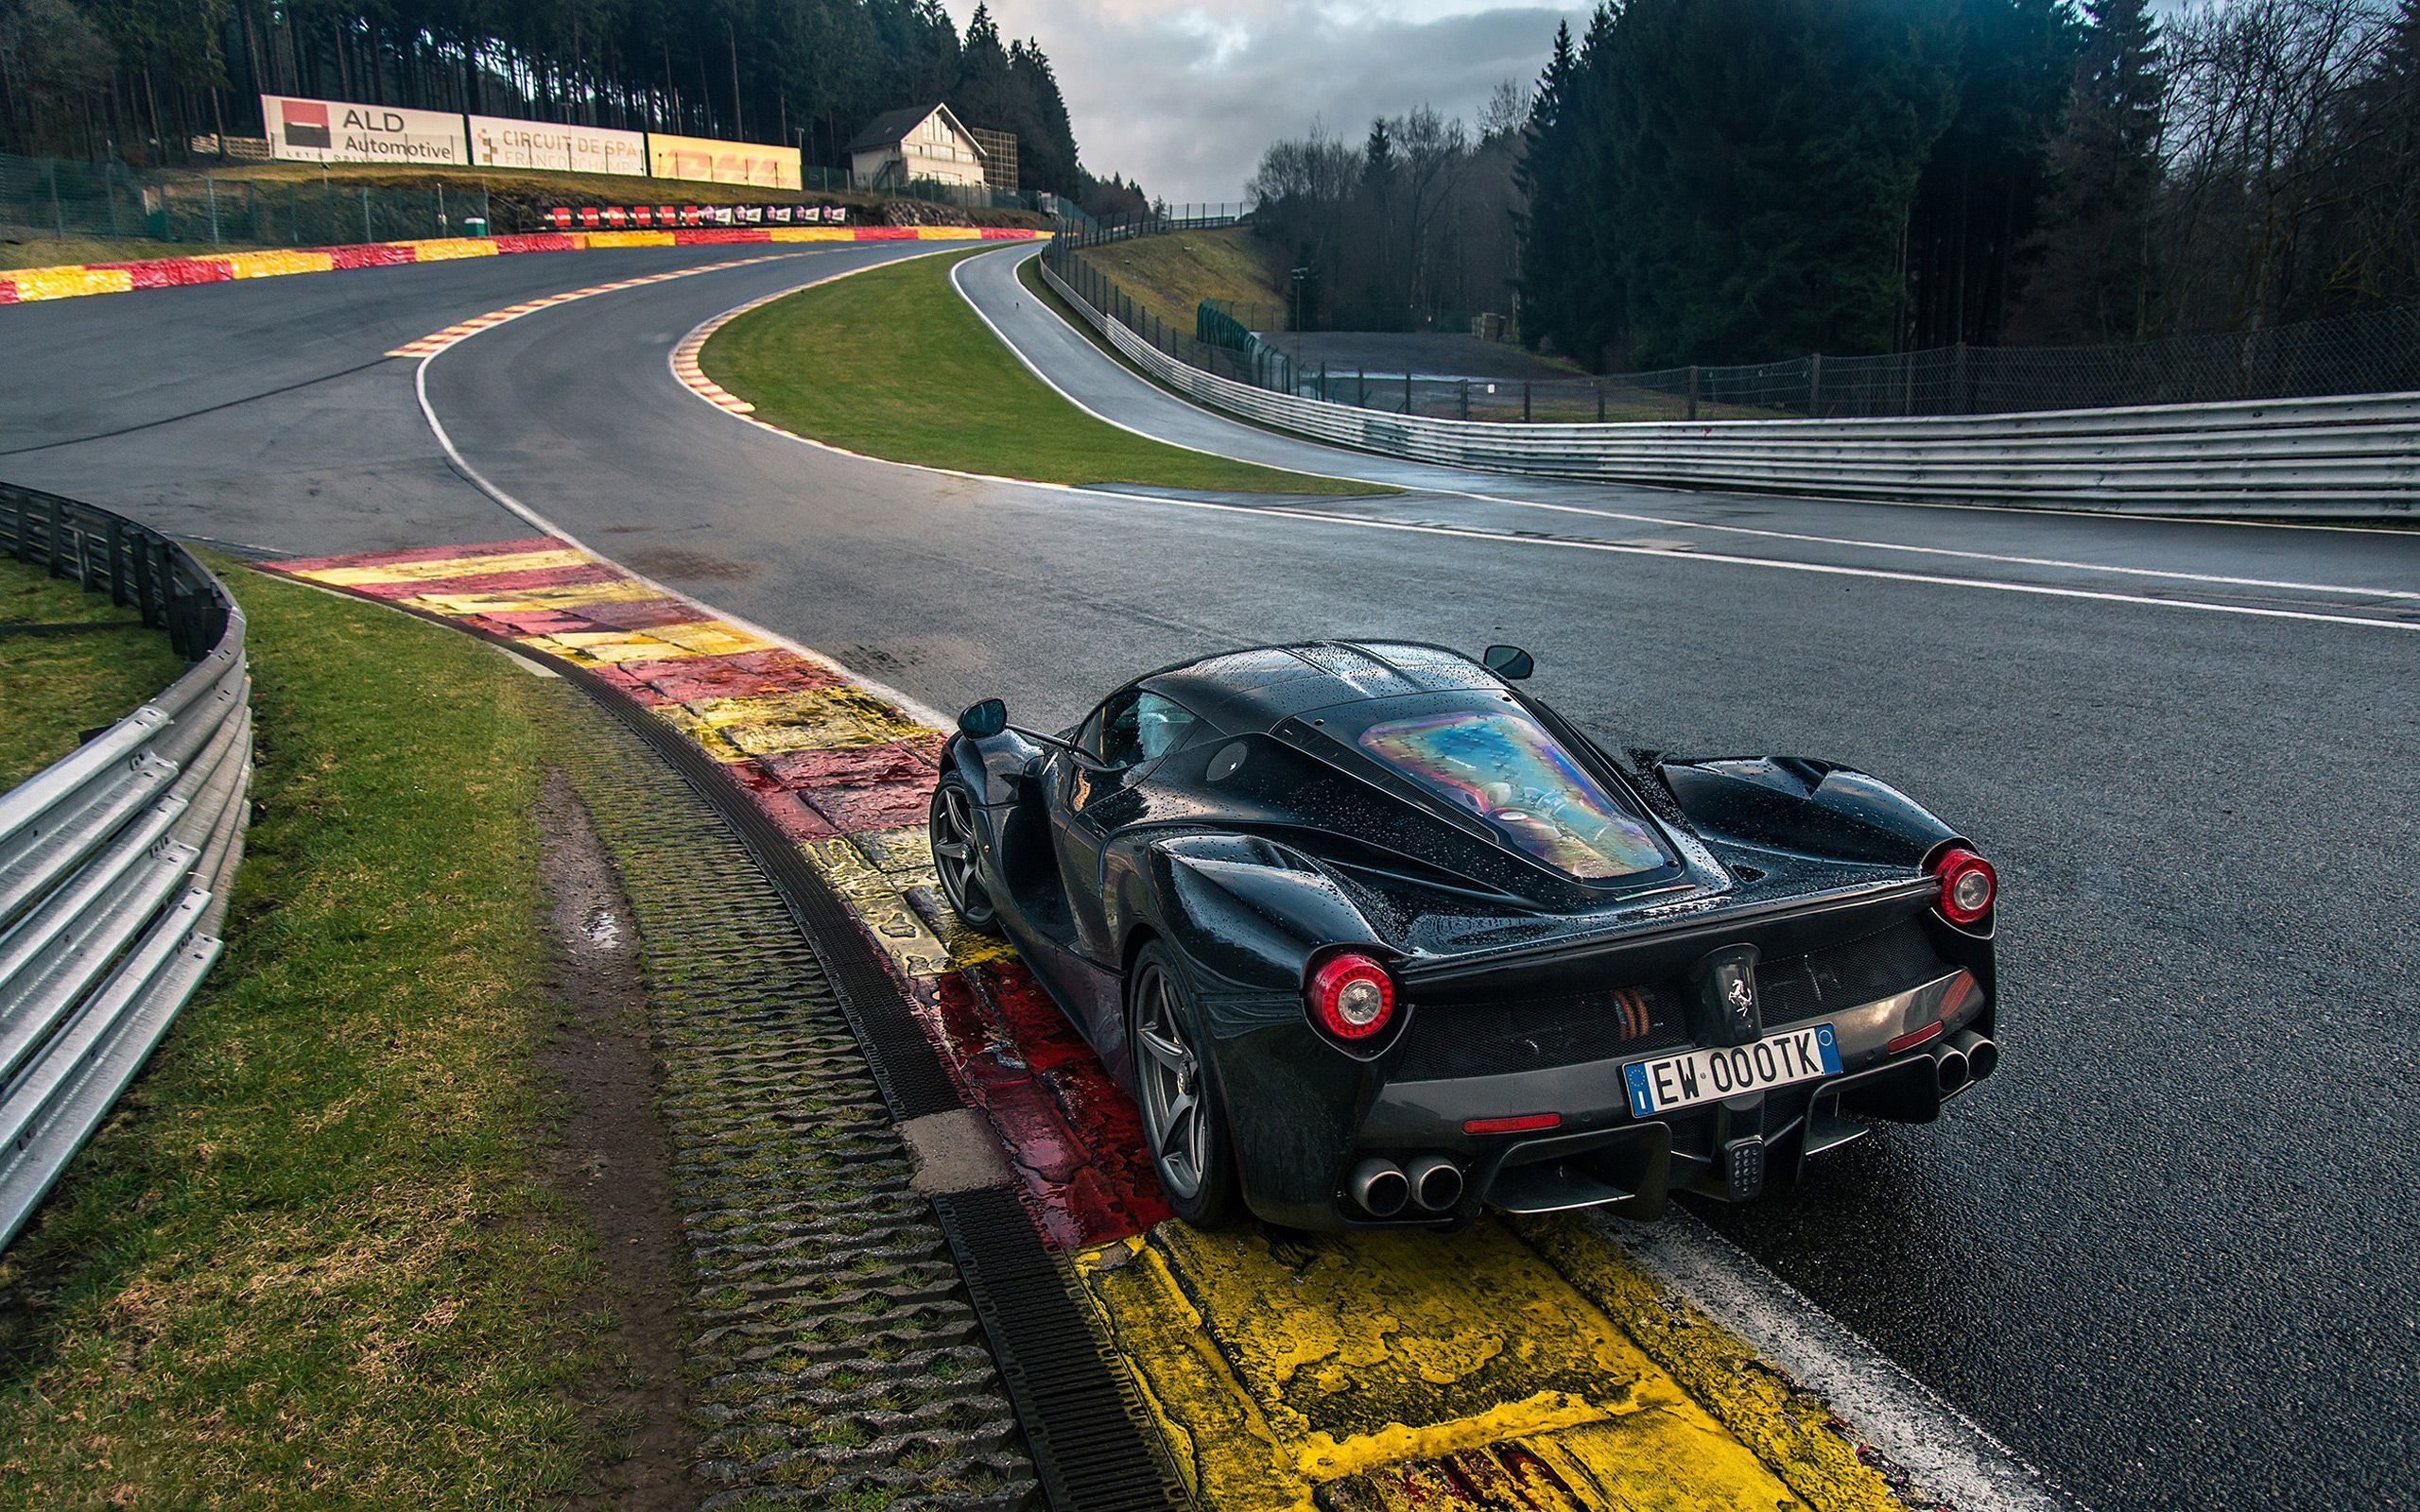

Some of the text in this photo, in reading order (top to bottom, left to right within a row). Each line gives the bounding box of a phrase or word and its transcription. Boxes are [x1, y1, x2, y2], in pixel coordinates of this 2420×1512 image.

[343, 110, 405, 132] ALD
[345, 135, 451, 160] Automotive
[503, 130, 637, 158] CIRCUIT DE SPA
[1652, 1056, 1701, 1106] EW
